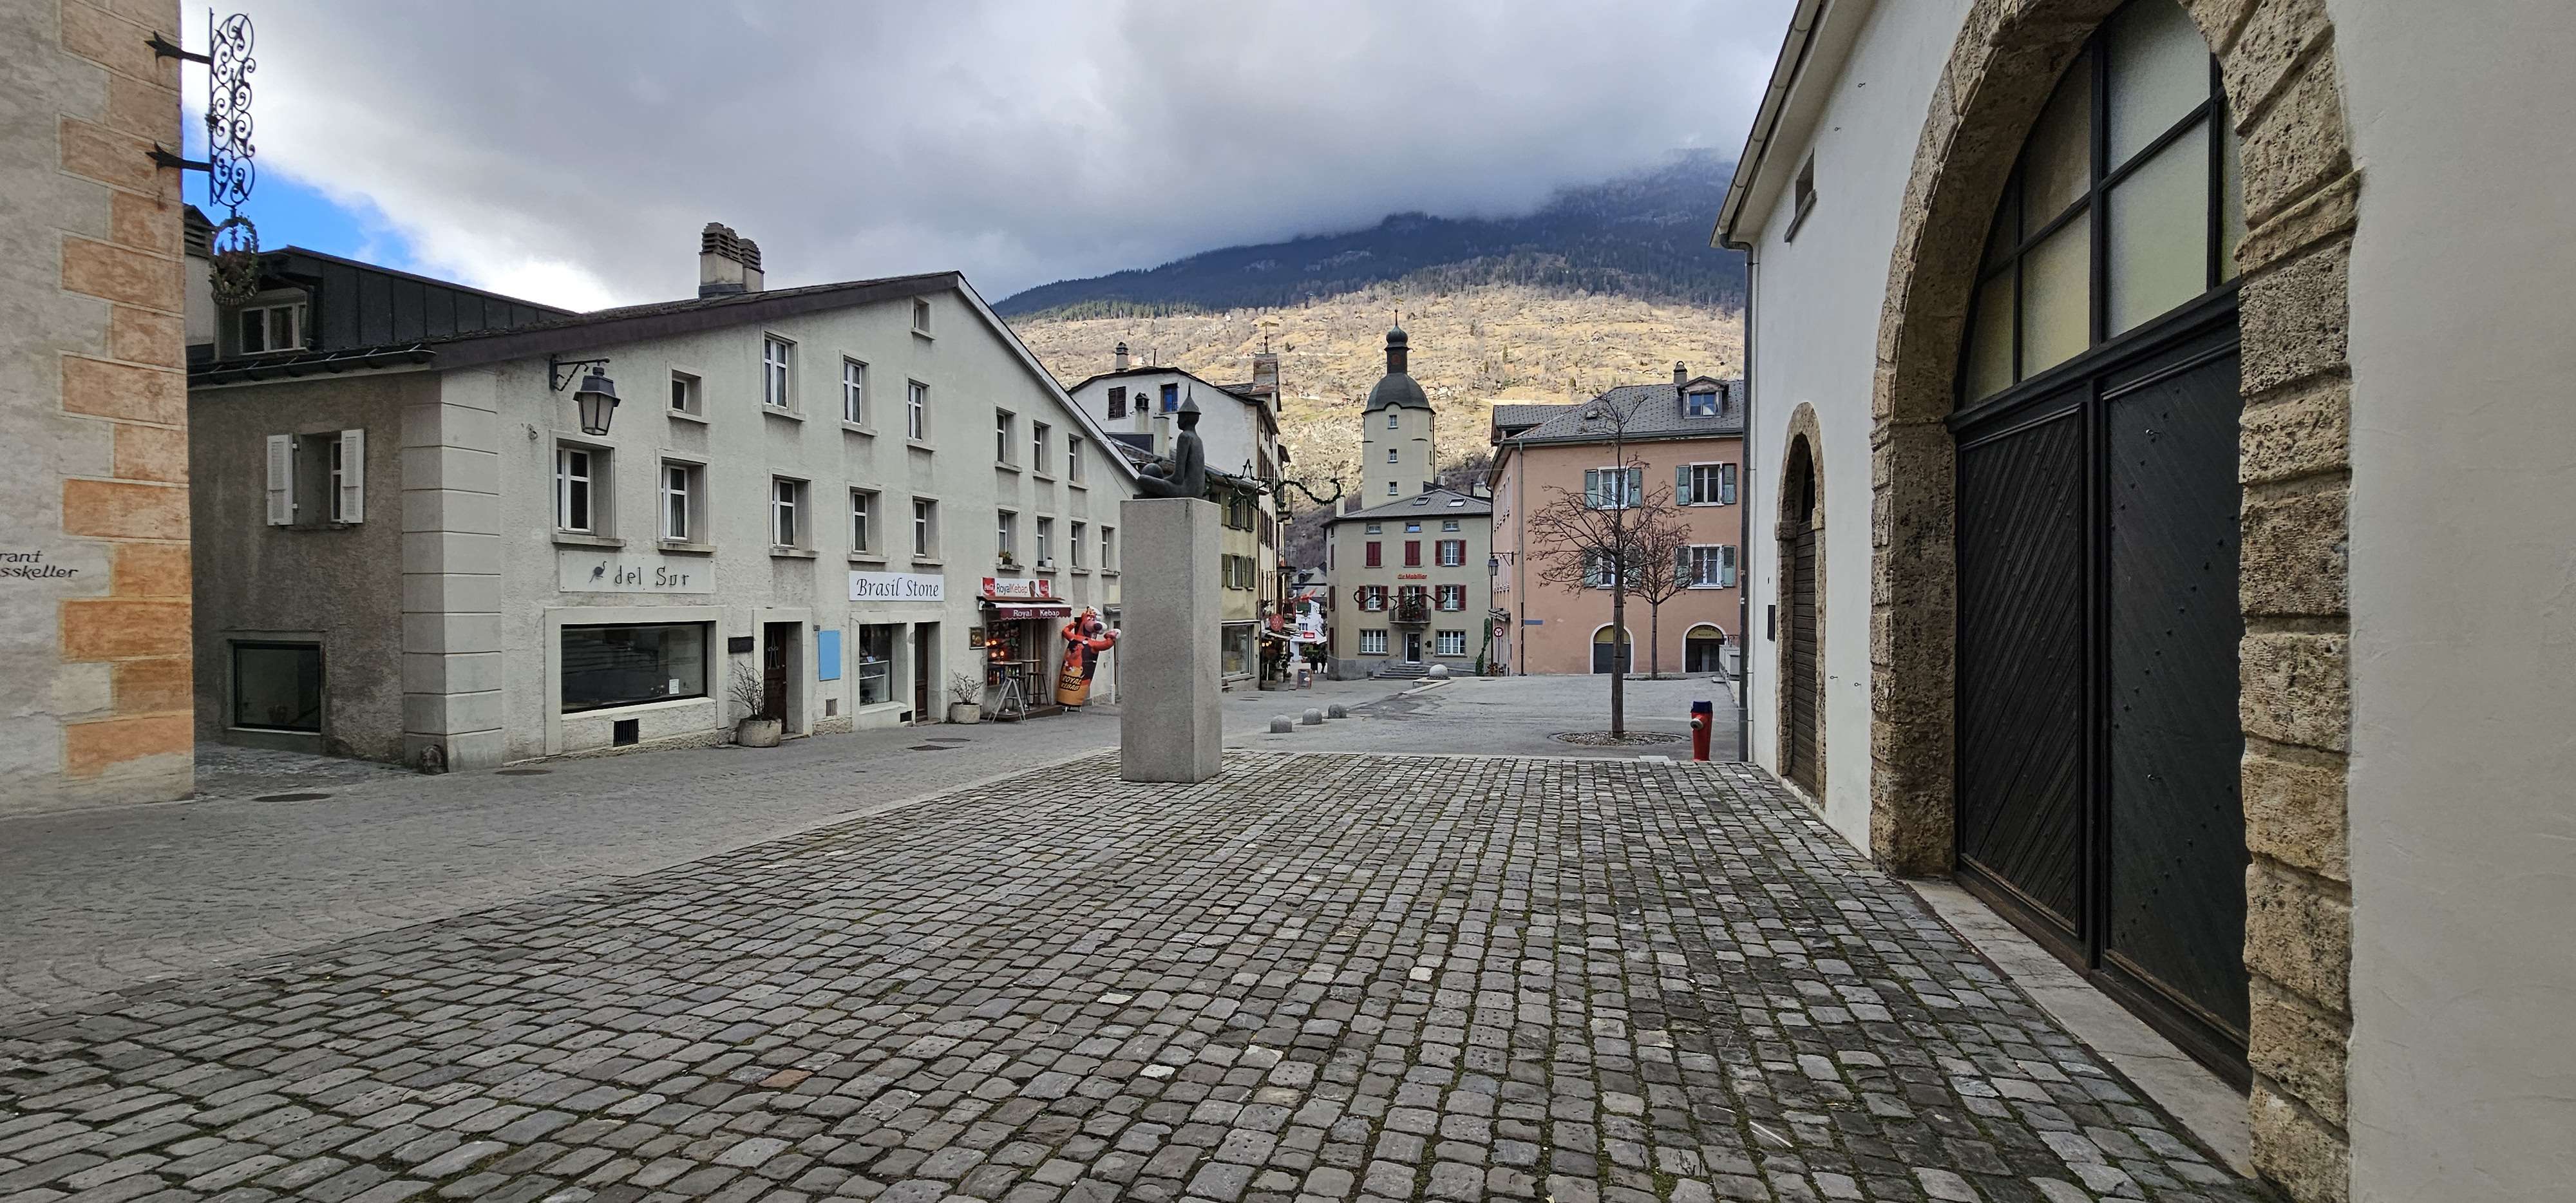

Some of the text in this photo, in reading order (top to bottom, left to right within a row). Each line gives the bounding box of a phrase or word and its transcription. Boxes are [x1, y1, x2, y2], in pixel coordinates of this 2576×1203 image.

[0, 565, 79, 580] sskeller
[614, 565, 690, 586] del Sur
[857, 578, 938, 596] Brasil Stone
[1013, 609, 1032, 618] Royal
